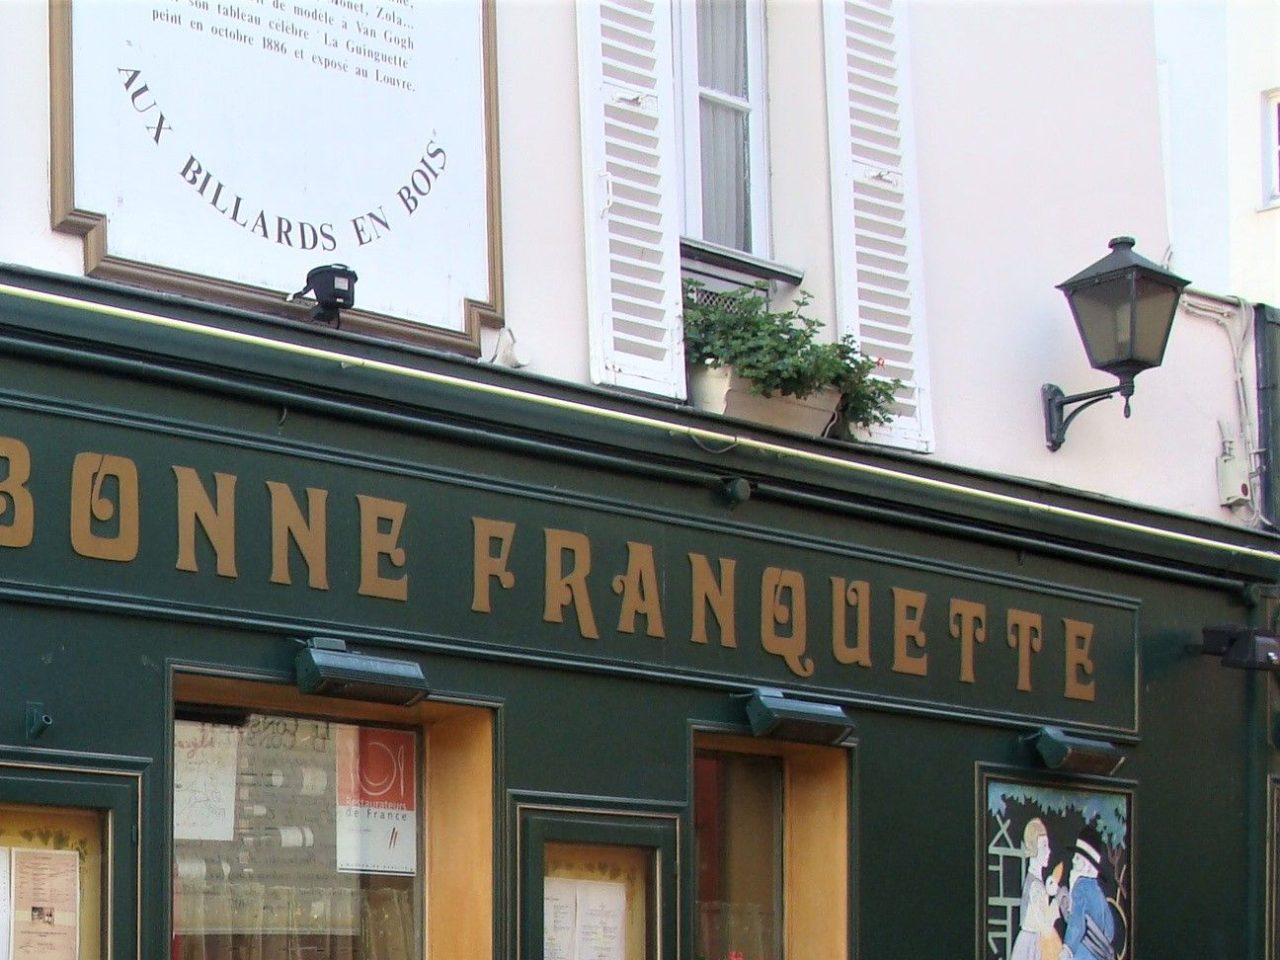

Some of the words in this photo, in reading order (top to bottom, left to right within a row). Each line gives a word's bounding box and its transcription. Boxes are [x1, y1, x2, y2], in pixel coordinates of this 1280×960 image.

[217, 3, 261, 26] tableau
[356, 20, 377, 39] Van
[383, 29, 414, 50] Gogh
[152, 8, 182, 26] peint
[190, 19, 203, 32] en
[211, 25, 254, 46] octobre
[262, 36, 287, 55] 1886
[294, 48, 304, 60] et
[355, 65, 369, 78] au
[375, 68, 416, 92] Louvre.
[117, 66, 173, 145] AUX
[179, 154, 337, 252] BILLARDS
[350, 205, 392, 247] EN
[396, 140, 447, 215] BOIS
[471, 516, 1096, 701] FRANQUETTE
[345, 808, 360, 818] de
[366, 809, 408, 821] France
